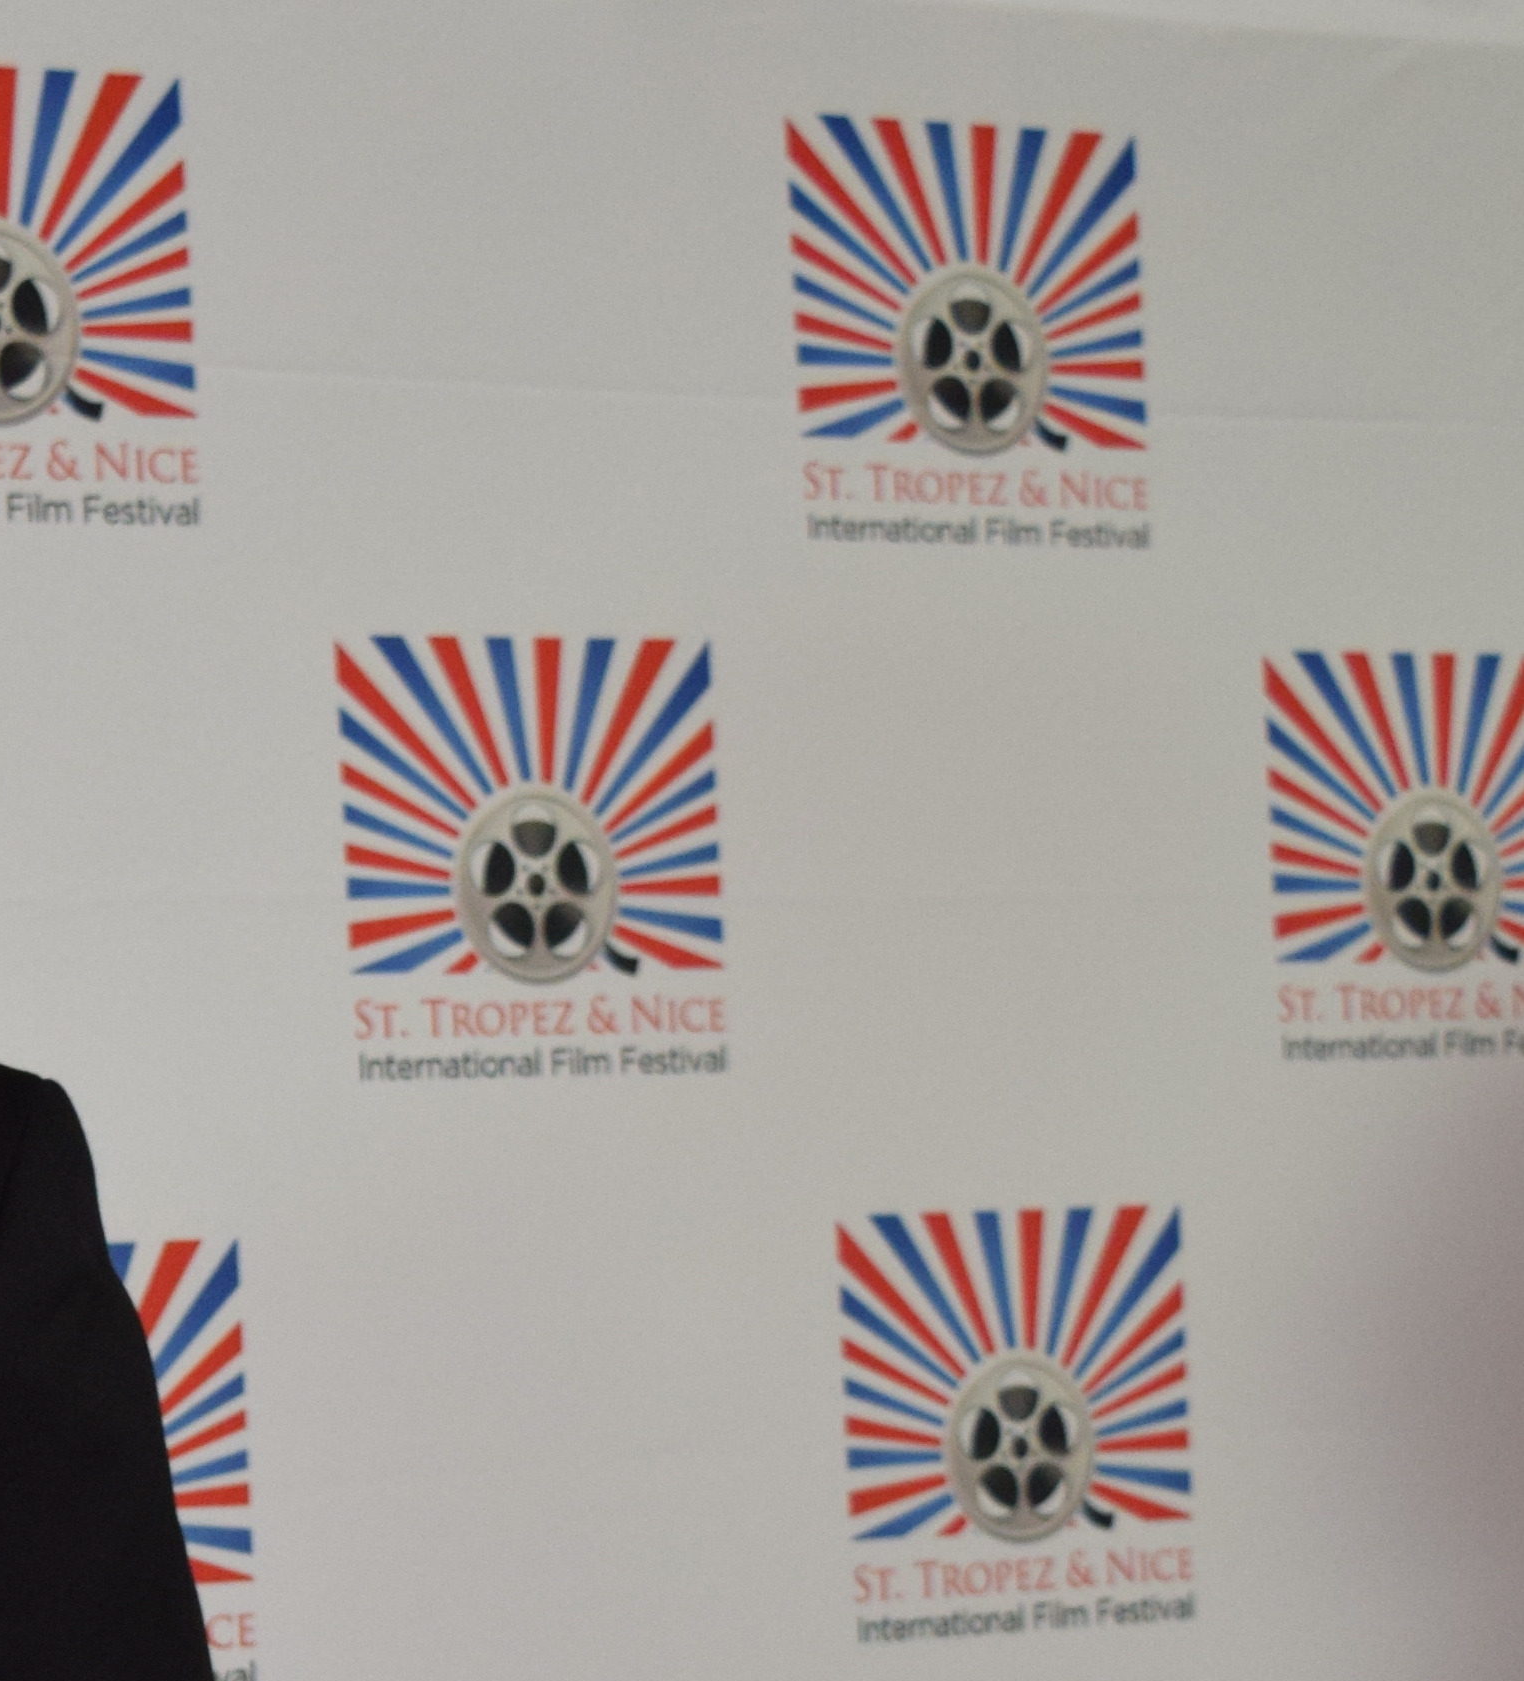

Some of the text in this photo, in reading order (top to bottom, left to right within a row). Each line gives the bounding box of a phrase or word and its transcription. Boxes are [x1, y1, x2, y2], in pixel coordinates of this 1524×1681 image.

[44, 438, 81, 482] &
[93, 441, 198, 485] NICE
[7, 491, 73, 522] Film
[82, 493, 201, 527] Festival
[421, 995, 576, 1038] TROPEZ
[586, 995, 621, 1036] &
[629, 995, 726, 1034] NICE
[359, 1045, 729, 1081] International Film Festival
[915, 1556, 1057, 1599] TROPEZ
[1065, 1551, 1097, 1589] &
[1104, 1546, 1194, 1585] NICE
[858, 1594, 1196, 1643] International Film Festival
